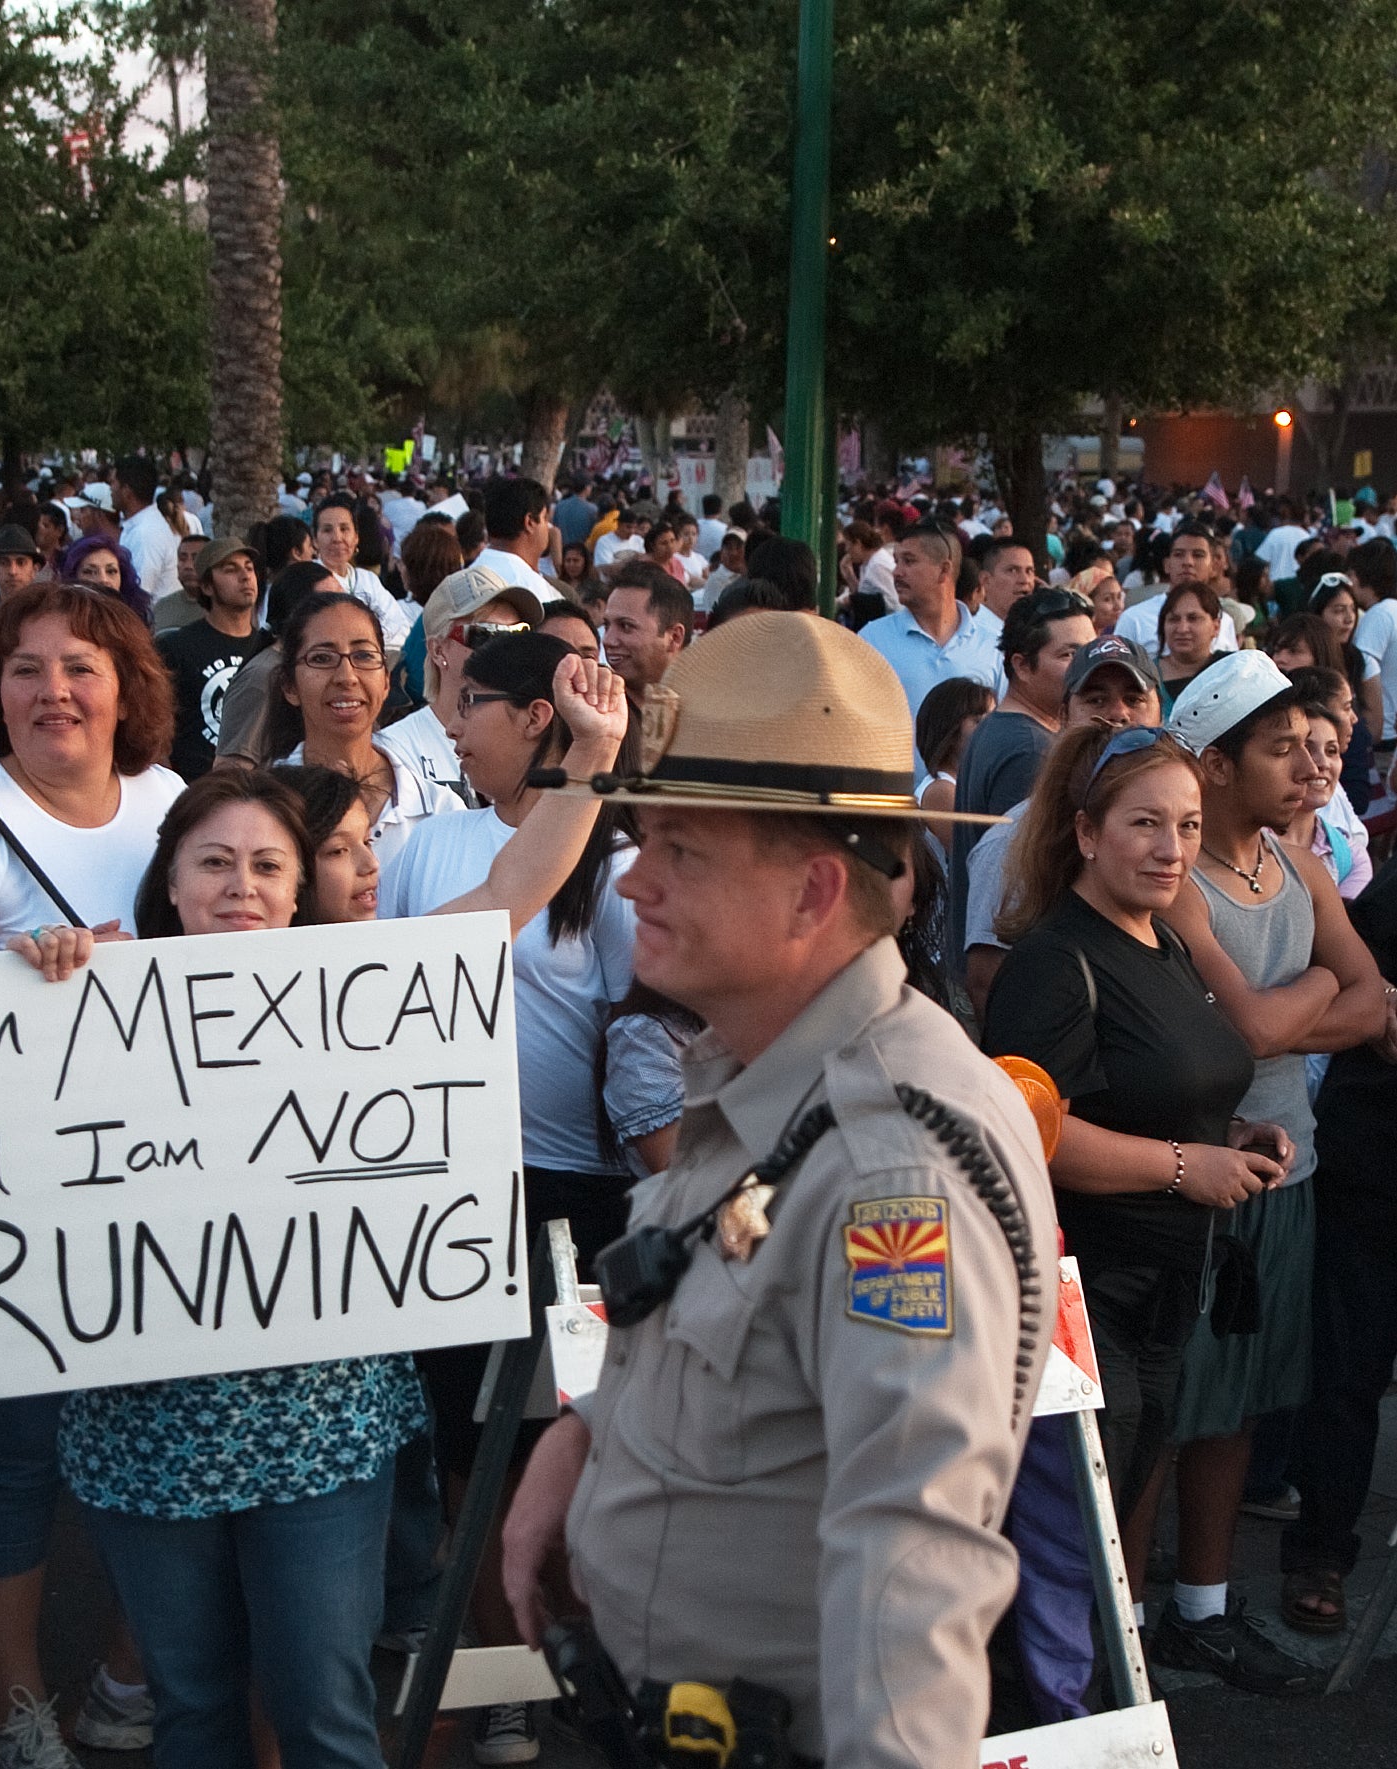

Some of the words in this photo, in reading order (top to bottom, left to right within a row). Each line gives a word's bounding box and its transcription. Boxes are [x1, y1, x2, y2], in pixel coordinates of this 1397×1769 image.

[55, 942, 507, 1107] MEXICAN
[56, 1121, 125, 1187] I
[248, 1081, 486, 1164] NOT
[860, 1202, 938, 1223] ARIZONA
[855, 1273, 942, 1295] DEPARTMENT
[870, 1290, 886, 1308] OF
[891, 1287, 941, 1301] PUBLIC
[890, 1303, 943, 1318] SAFETY
